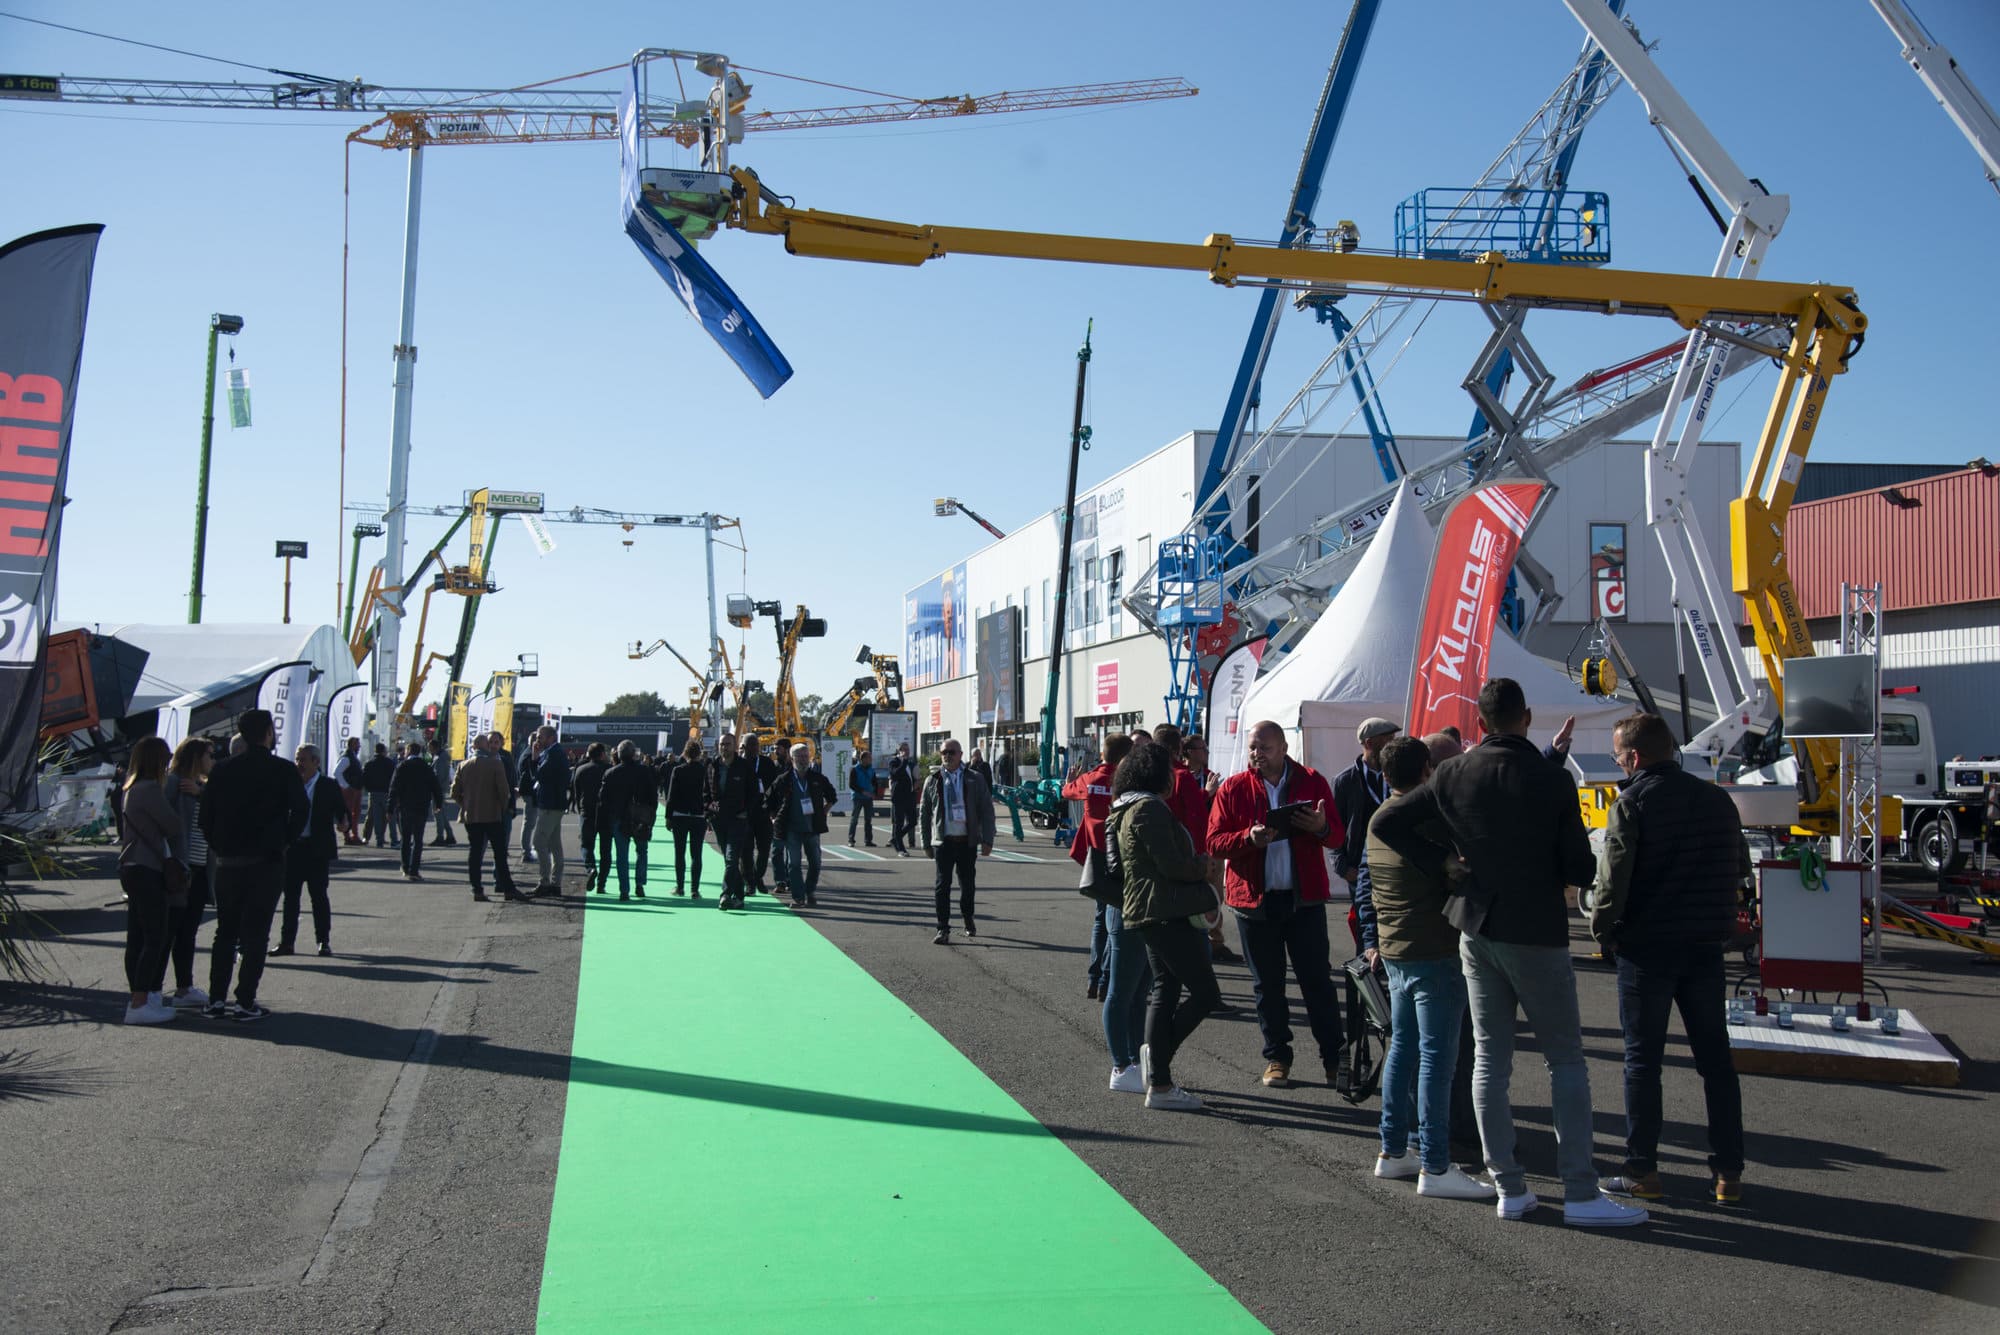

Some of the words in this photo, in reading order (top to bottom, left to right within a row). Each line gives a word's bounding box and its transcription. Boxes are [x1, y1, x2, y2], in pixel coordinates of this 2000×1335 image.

[21, 79, 55, 90] 16m
[440, 123, 480, 132] POTAIN
[1696, 363, 1721, 422] snake
[491, 493, 540, 504] MERLO
[1778, 581, 1797, 619] Louez
[1791, 621, 1808, 644] moi
[340, 695, 353, 754] ROPEL
